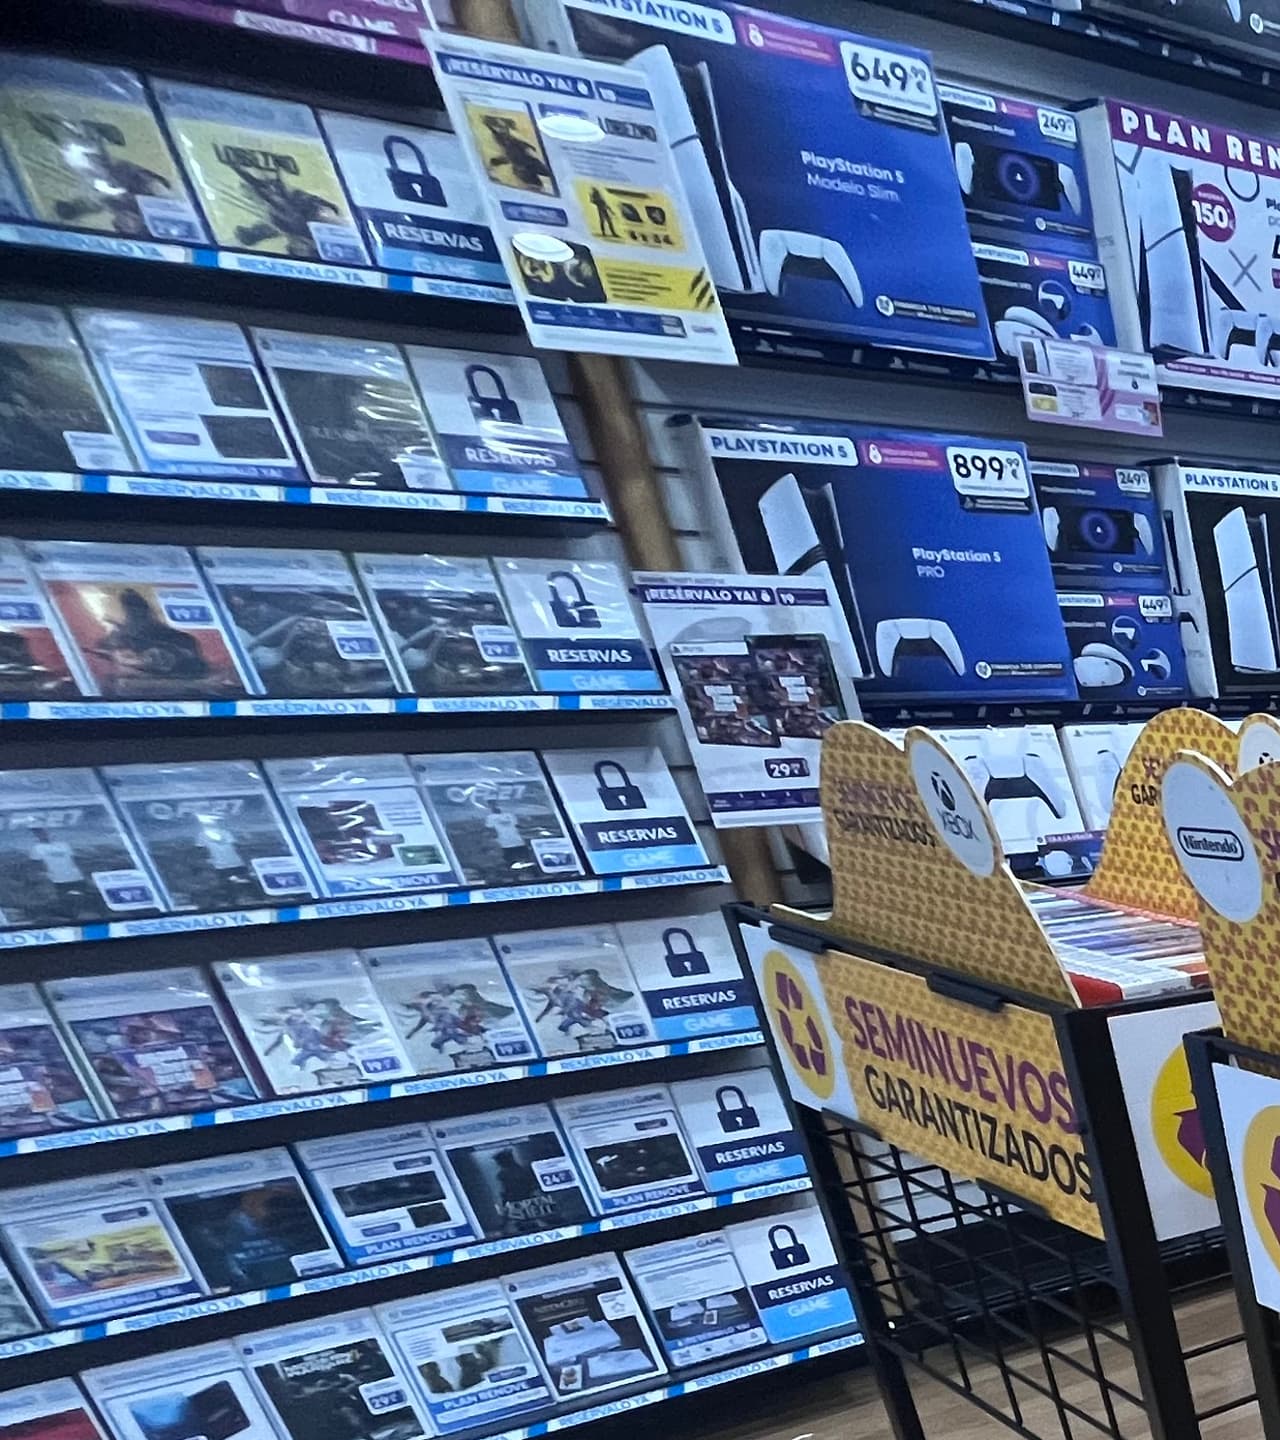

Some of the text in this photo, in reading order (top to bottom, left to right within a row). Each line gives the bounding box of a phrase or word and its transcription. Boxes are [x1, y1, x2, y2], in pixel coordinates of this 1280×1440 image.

[851, 52, 910, 92] 649
[1120, 107, 1211, 153] PLAN
[801, 149, 891, 182] PlayStation
[806, 171, 900, 201] Modelo Slim
[384, 221, 483, 252] RESERVAS
[464, 446, 557, 470] RESERVAS
[712, 435, 832, 458] PLAYSTATION
[953, 452, 1003, 482] 899
[1185, 473, 1269, 492] PLAYSTATION
[913, 547, 990, 564] PlayStation
[917, 565, 945, 579] PRO
[546, 646, 632, 666] RESERVAS
[597, 825, 678, 846] RESERVAS
[1183, 832, 1240, 857] Nintendo
[662, 989, 737, 1011] RESERVAS
[844, 995, 1080, 1135] SEMINUEVOS
[864, 1064, 1092, 1202] GARANTIZADOS
[714, 1139, 786, 1166] RESERVAS
[767, 1273, 834, 1301] RESERVAS
